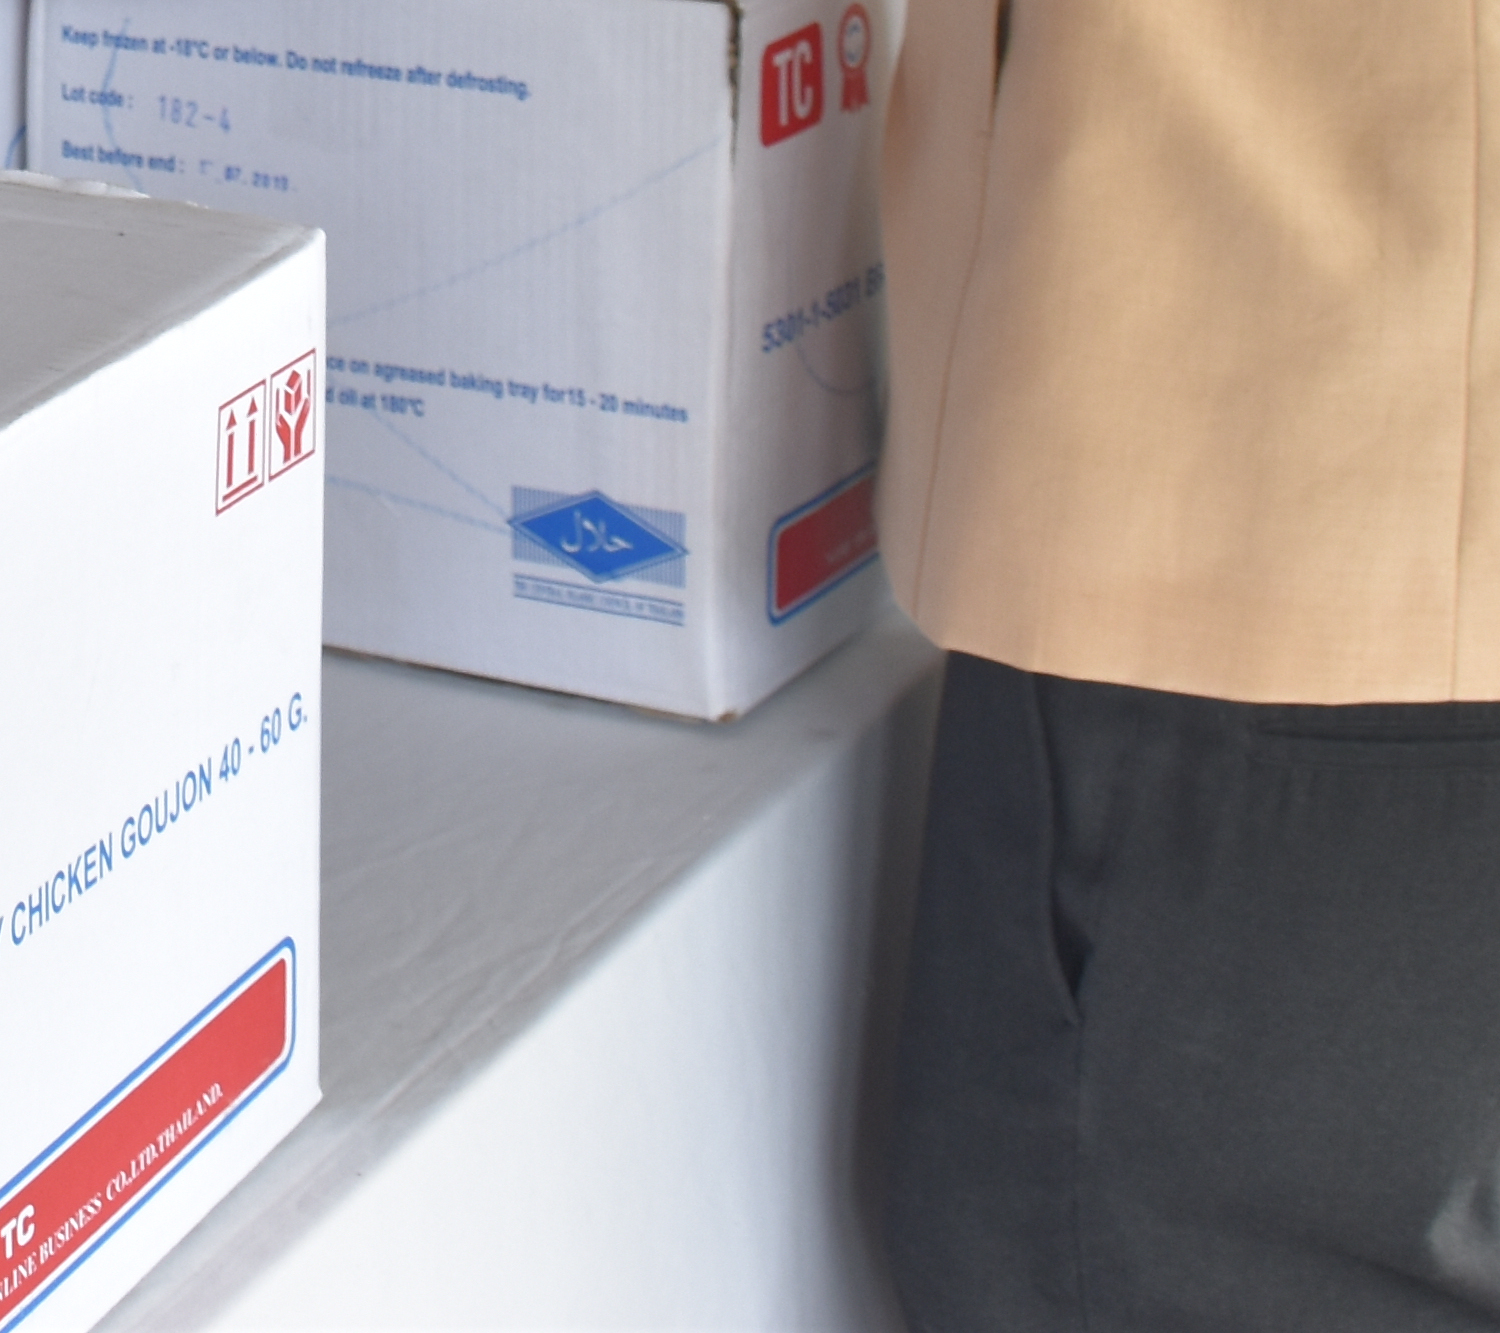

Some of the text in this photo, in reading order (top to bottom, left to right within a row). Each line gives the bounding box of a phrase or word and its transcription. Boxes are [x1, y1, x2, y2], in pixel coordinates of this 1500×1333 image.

[773, 40, 812, 131] TC
[10, 832, 112, 946] CHICKEN
[120, 757, 211, 859] GOUJON
[218, 736, 241, 781] 40
[259, 707, 281, 753] 60
[287, 691, 307, 731] G.
[0, 1203, 36, 1259] TC
[38, 1192, 103, 1266] BUSINESS
